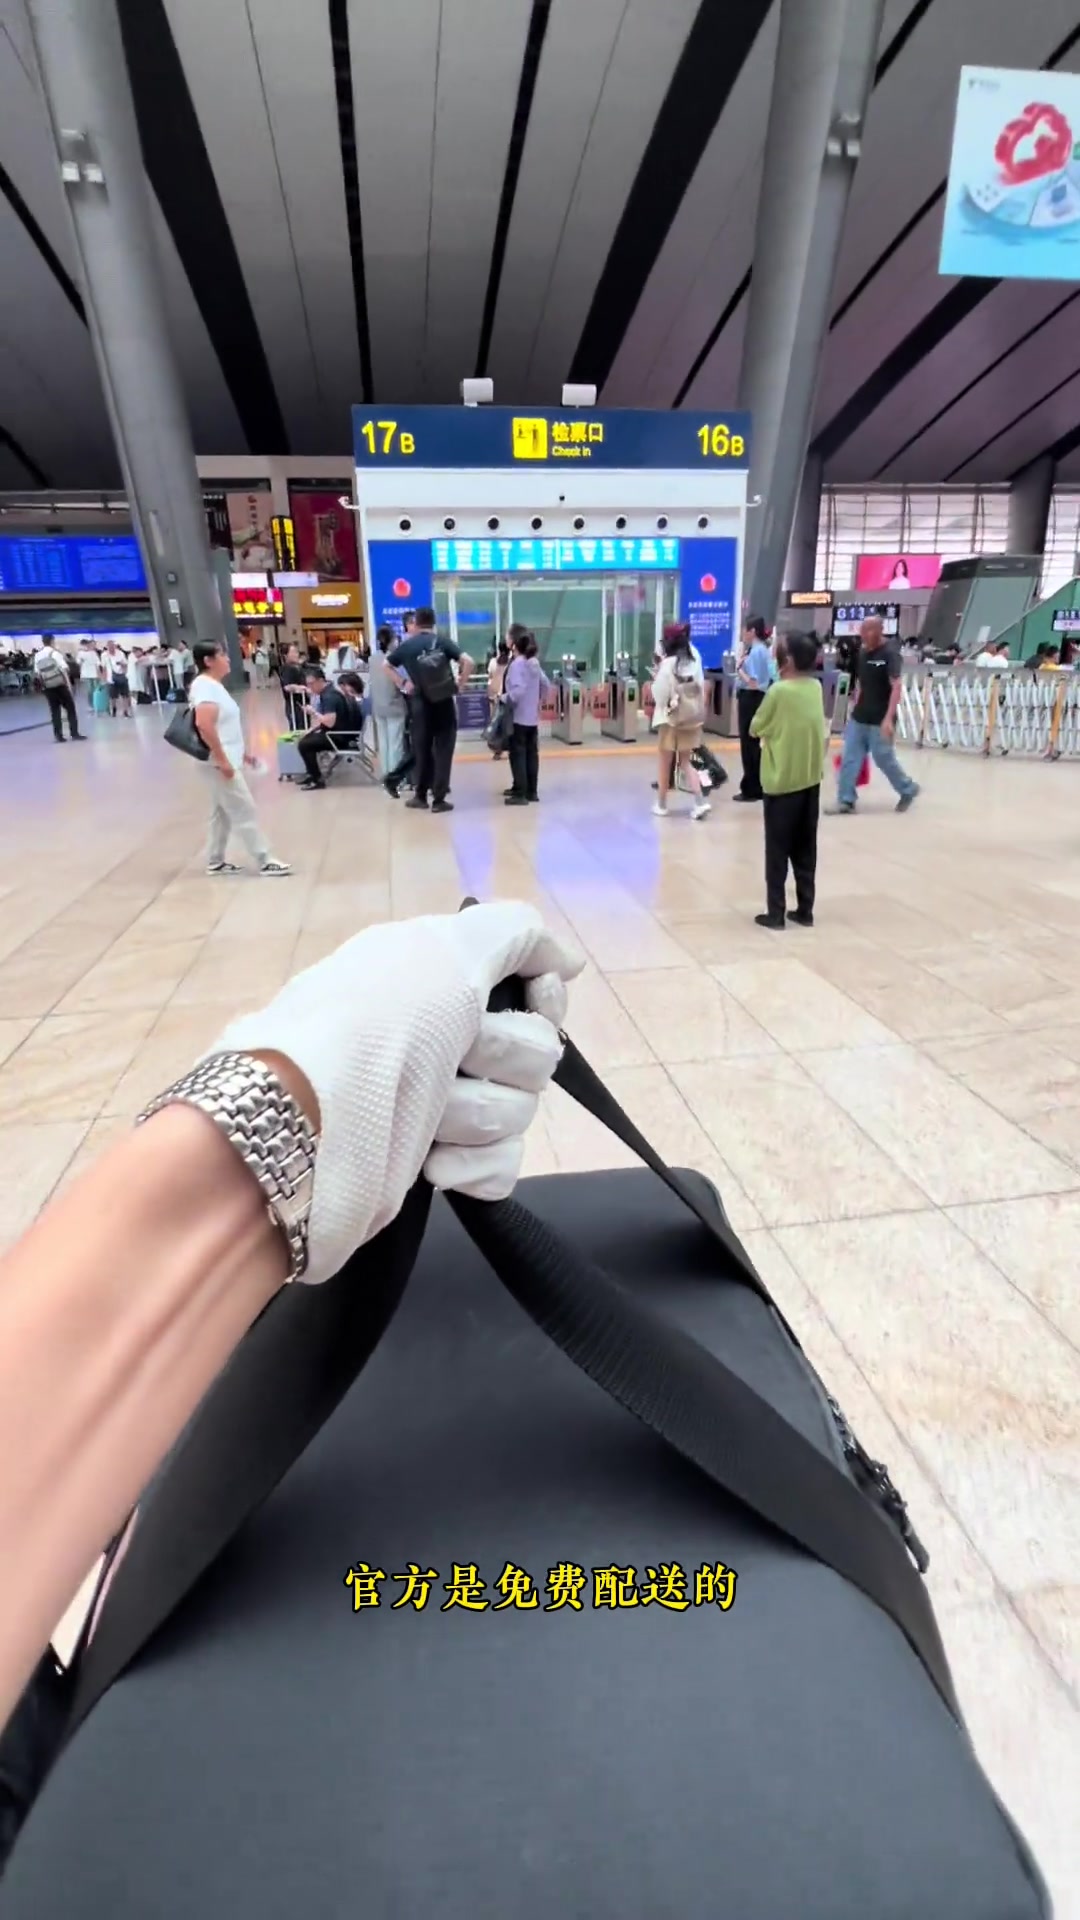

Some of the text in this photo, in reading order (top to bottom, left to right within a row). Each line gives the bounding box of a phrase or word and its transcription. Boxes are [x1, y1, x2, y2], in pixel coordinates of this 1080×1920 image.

[362, 420, 415, 454] 17B
[552, 421, 603, 443] 检票口
[697, 424, 744, 456] 16B
[552, 446, 581, 456] Check
